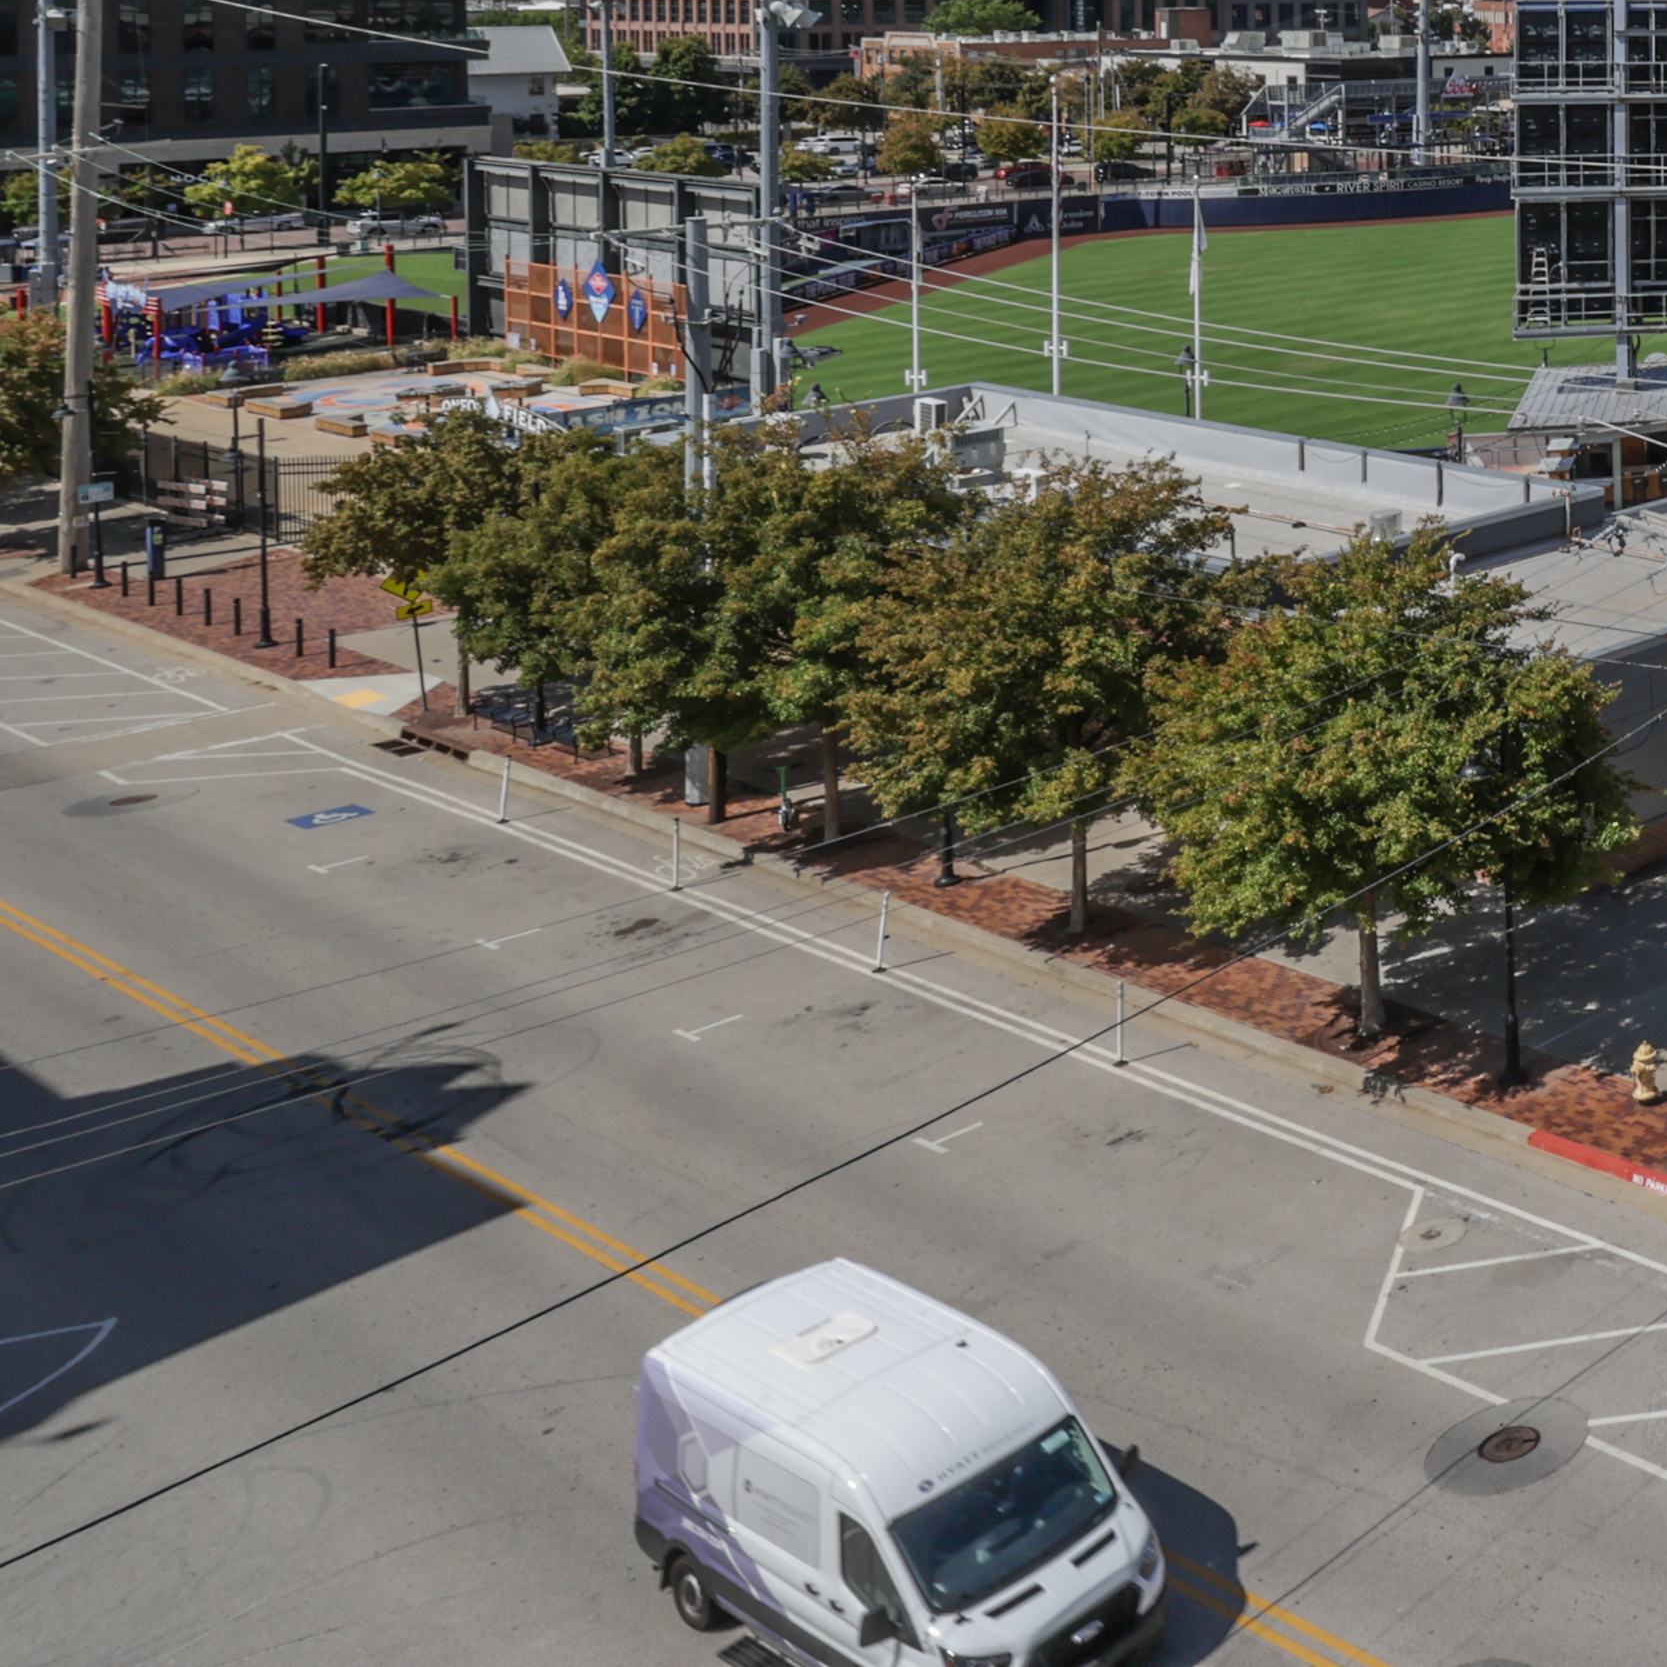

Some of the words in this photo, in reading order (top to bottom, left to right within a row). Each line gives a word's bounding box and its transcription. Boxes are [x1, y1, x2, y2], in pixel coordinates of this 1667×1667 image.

[1336, 182, 1370, 194] RIVER
[1373, 179, 1405, 192] SPIRIT
[1407, 180, 1437, 188] CASINO
[1438, 178, 1464, 186] RESORT
[954, 209, 994, 219] FERGUSON
[797, 218, 820, 229] that
[823, 215, 867, 228] inspires
[504, 404, 547, 434] FIELD
[1632, 1173, 1644, 1186] NO
[936, 1450, 980, 1482] HYATT
